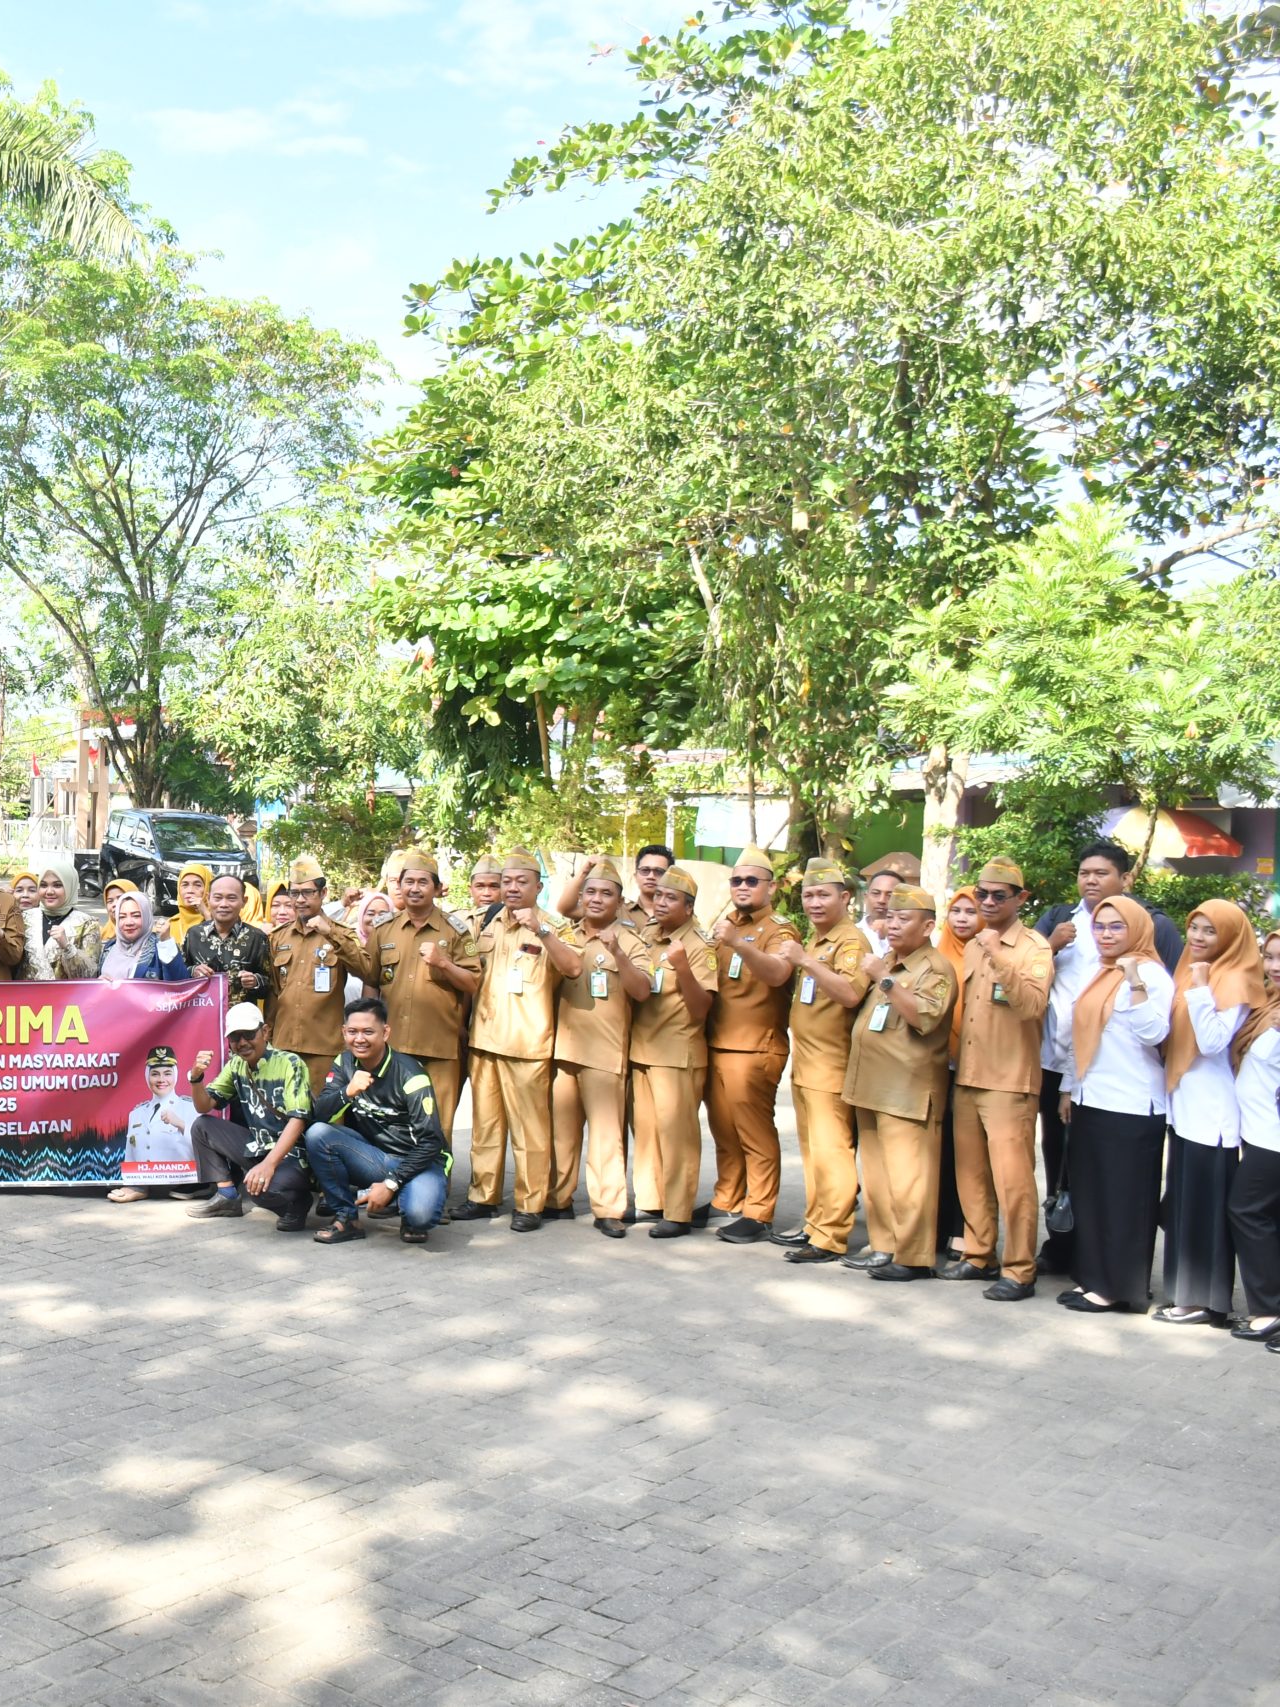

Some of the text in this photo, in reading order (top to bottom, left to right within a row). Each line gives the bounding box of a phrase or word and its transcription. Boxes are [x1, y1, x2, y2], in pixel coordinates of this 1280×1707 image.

[9, 1053, 120, 1069] MASYARAKAT
[21, 1075, 68, 1090] UMUM
[71, 1072, 119, 1090] (DAU)
[153, 1163, 191, 1171] ANANDA
